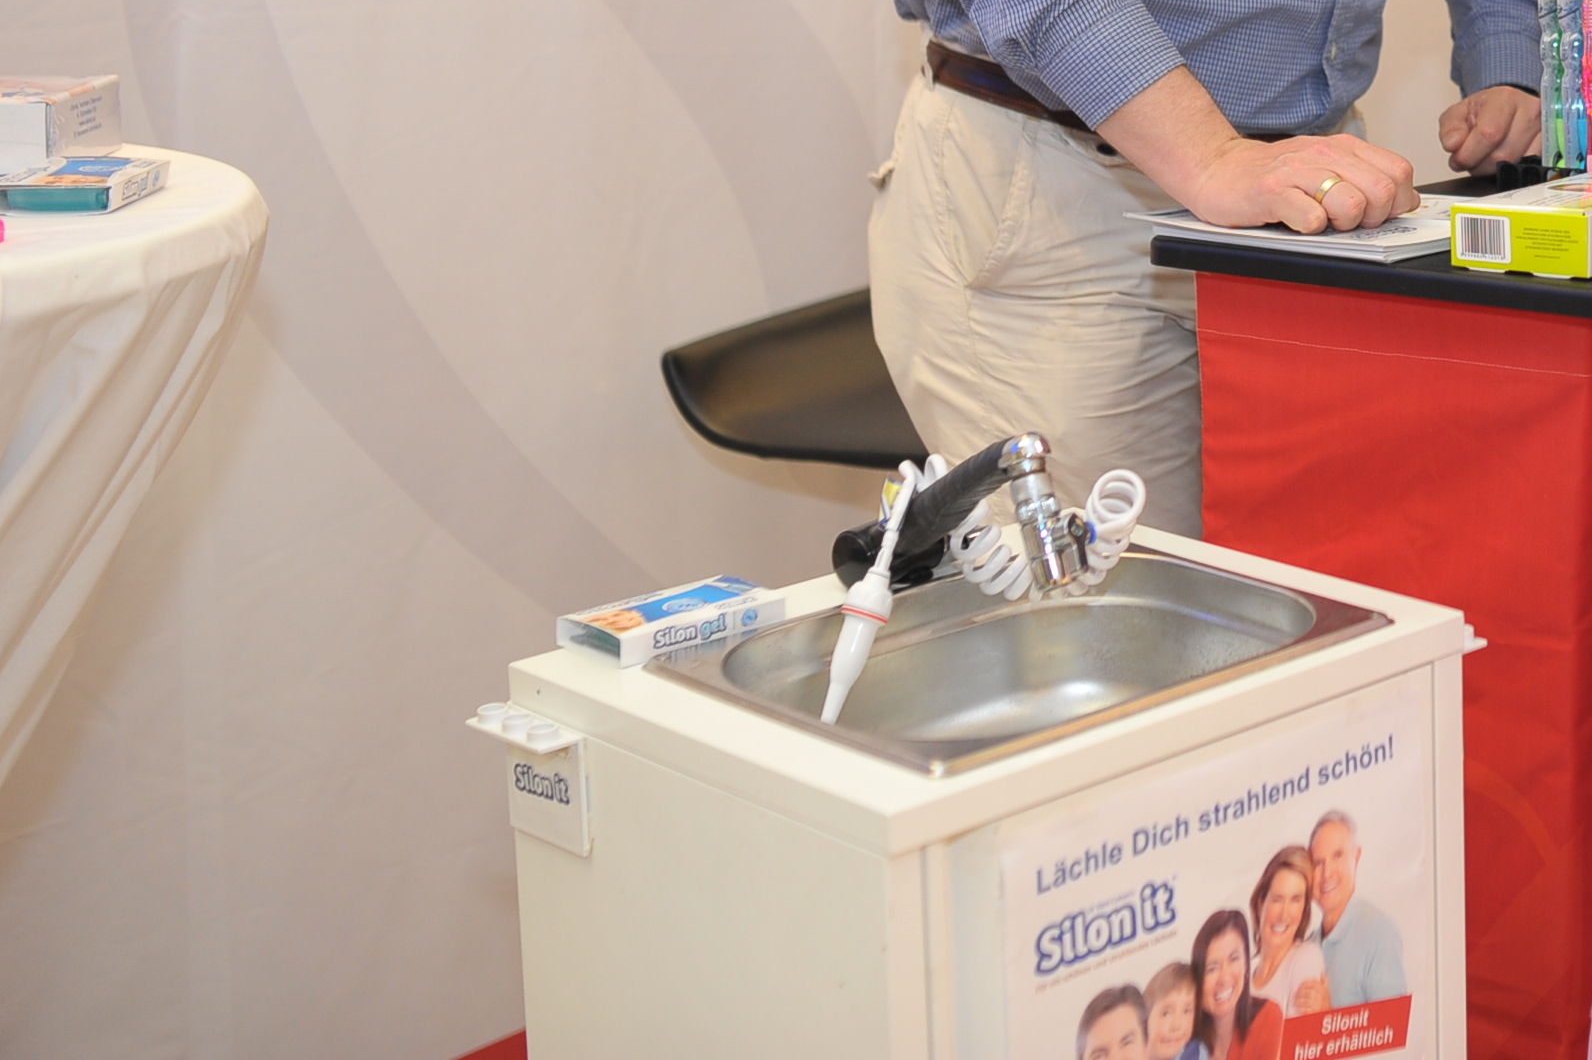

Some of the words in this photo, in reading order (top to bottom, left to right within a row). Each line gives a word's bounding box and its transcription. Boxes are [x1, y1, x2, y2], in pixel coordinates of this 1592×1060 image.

[653, 625, 698, 649] Silon
[699, 612, 728, 640] gel
[513, 763, 555, 801] Silon
[553, 772, 570, 806] it
[1036, 842, 1123, 896] Lächle
[1132, 815, 1191, 857] Dich
[1198, 767, 1311, 833] strahlend
[1317, 734, 1395, 787] schön!
[1034, 904, 1138, 976] Silon
[1140, 882, 1177, 933] it
[1321, 1007, 1370, 1036] Silonit
[1294, 1040, 1324, 1060] hier
[1325, 1024, 1395, 1056] erhältlich
